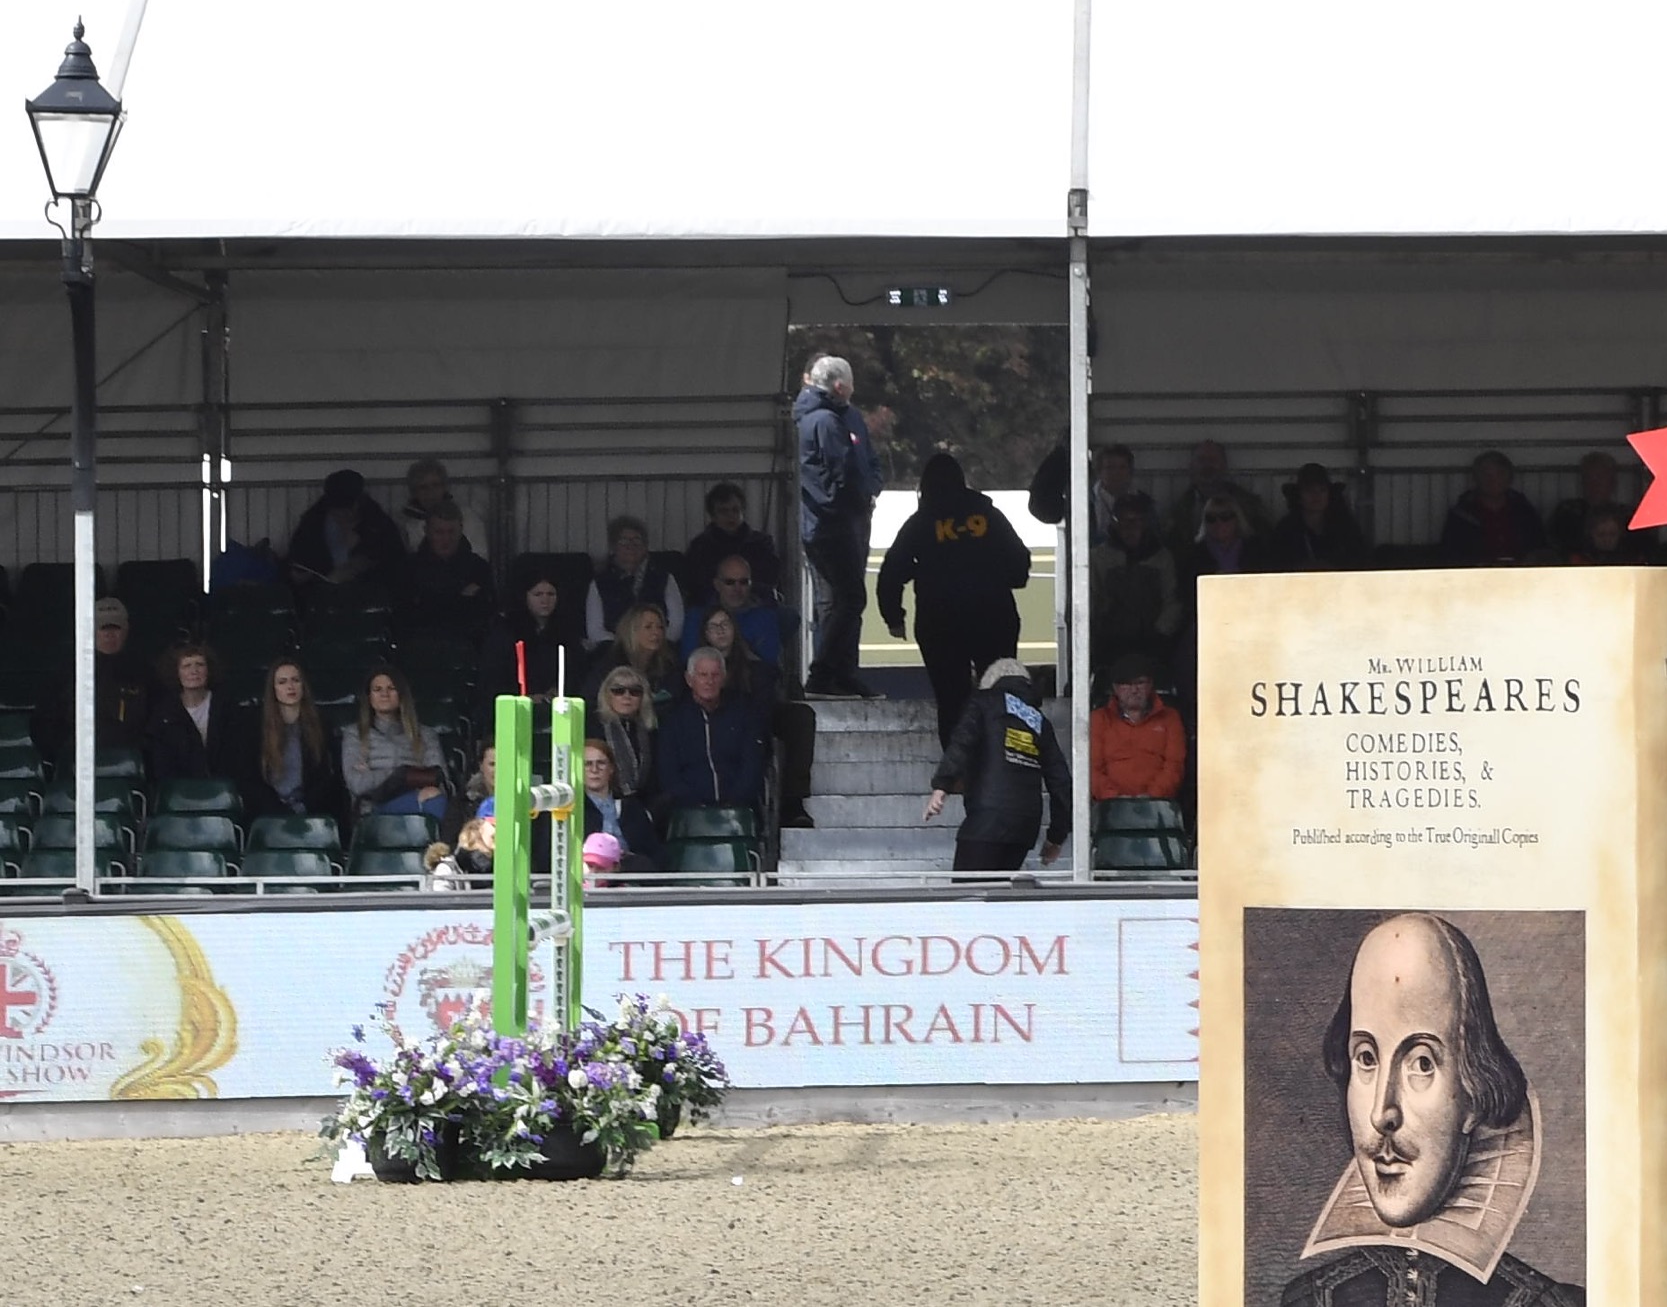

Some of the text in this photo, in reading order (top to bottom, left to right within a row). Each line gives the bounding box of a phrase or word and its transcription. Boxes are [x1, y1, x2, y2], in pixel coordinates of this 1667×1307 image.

[936, 515, 987, 542] K-9
[1396, 656, 1483, 673] WILLIAM
[1251, 678, 1582, 717] SHAKESPEARES
[1346, 732, 1463, 756] COMEDIES,
[1346, 760, 1494, 784] HISTORIES, &
[1346, 788, 1482, 809] TRAGEDIES.
[1345, 828, 1392, 848] according
[1396, 832, 1405, 843] to
[1407, 827, 1423, 843] the
[1425, 827, 1451, 843] True
[1502, 828, 1539, 848] Copies
[609, 935, 1070, 981] THE KINGDOM
[741, 1002, 1036, 1047] BAHRAIN
[0, 1042, 116, 1063] INDSOR
[8, 1065, 91, 1085] SHOW
